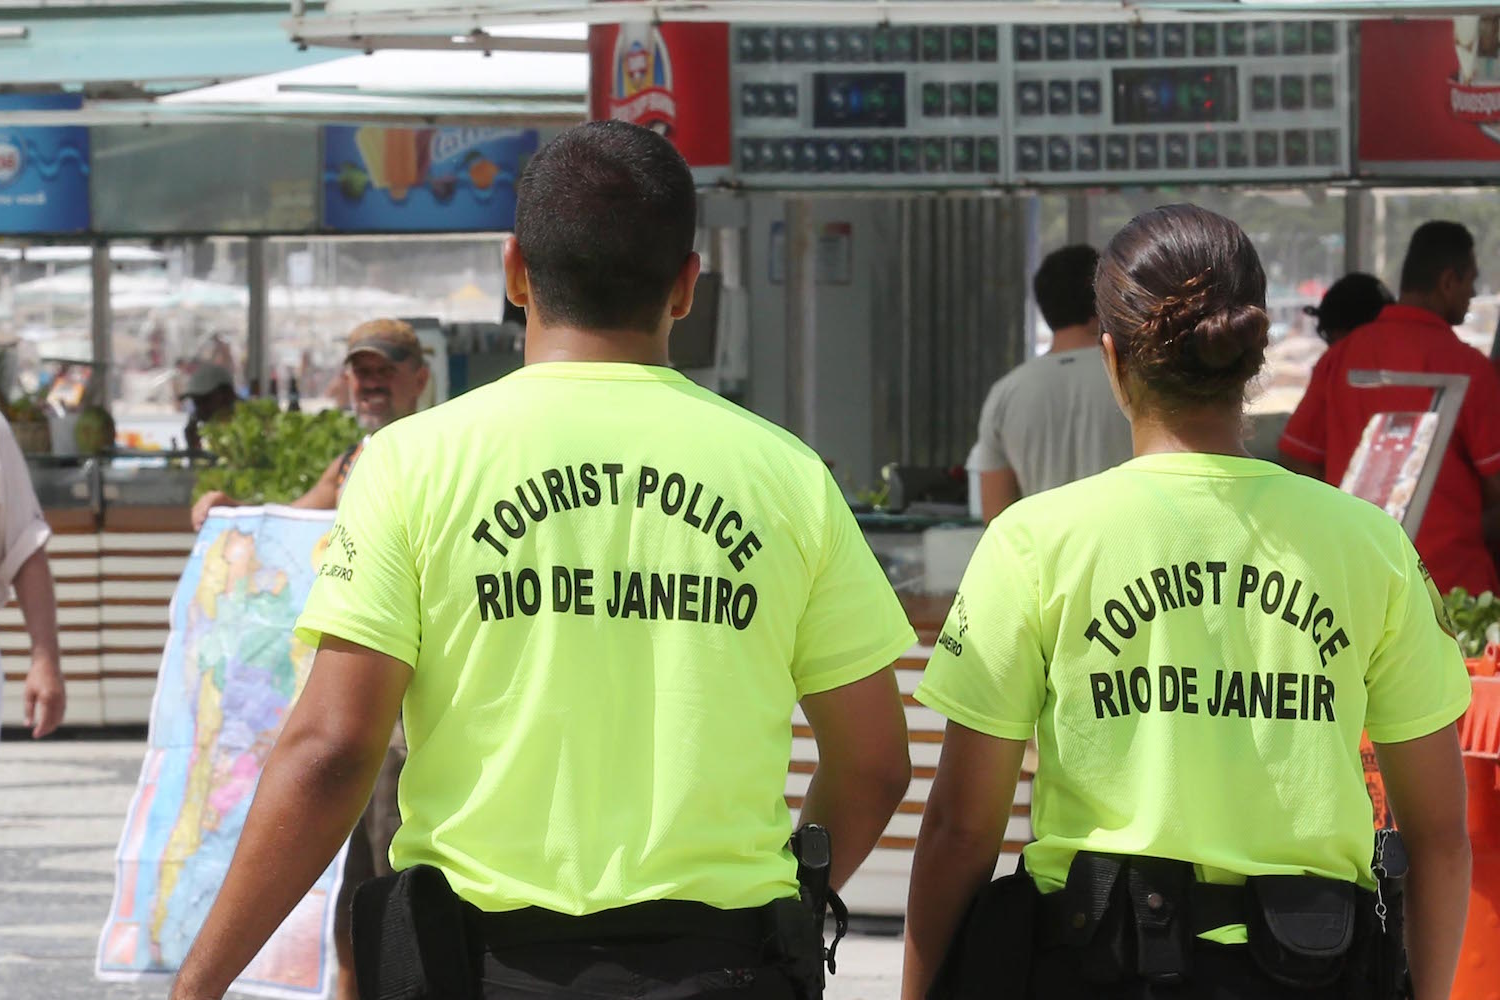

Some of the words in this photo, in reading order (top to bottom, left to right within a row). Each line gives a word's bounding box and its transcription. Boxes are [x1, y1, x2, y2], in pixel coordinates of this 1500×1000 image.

[472, 463, 623, 557] TOURIST
[636, 465, 763, 573] POLICE
[475, 566, 542, 621] RIO
[552, 565, 595, 617] DE
[606, 568, 758, 631] JANEIRO
[1083, 561, 1227, 657] TOURIST
[1237, 564, 1351, 668] POLICE
[1089, 665, 1152, 719] RIO
[1159, 665, 1199, 714] DE
[1207, 669, 1336, 722] JANEIR
